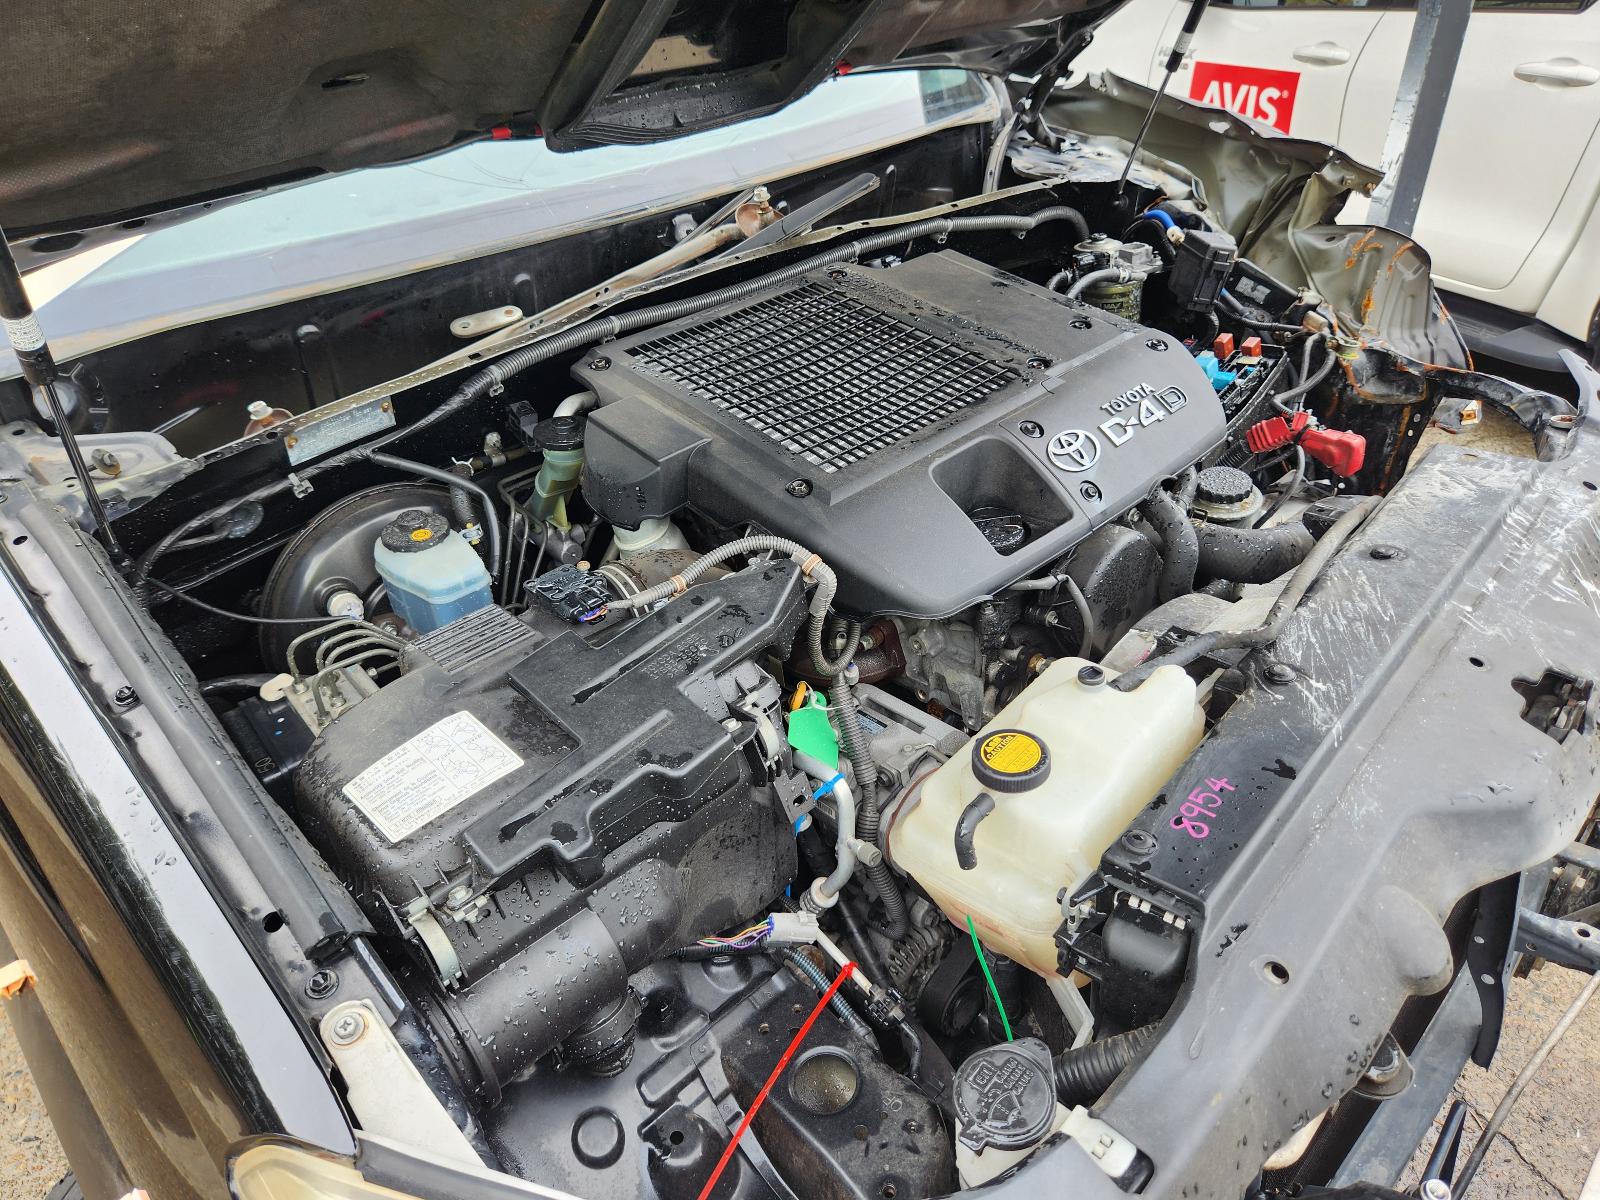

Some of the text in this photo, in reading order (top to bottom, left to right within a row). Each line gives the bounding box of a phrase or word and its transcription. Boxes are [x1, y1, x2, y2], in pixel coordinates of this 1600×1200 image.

[1100, 382, 1155, 416] TOYOTA
[986, 735, 1014, 759] CAUTION
[1169, 776, 1235, 839] 8954
